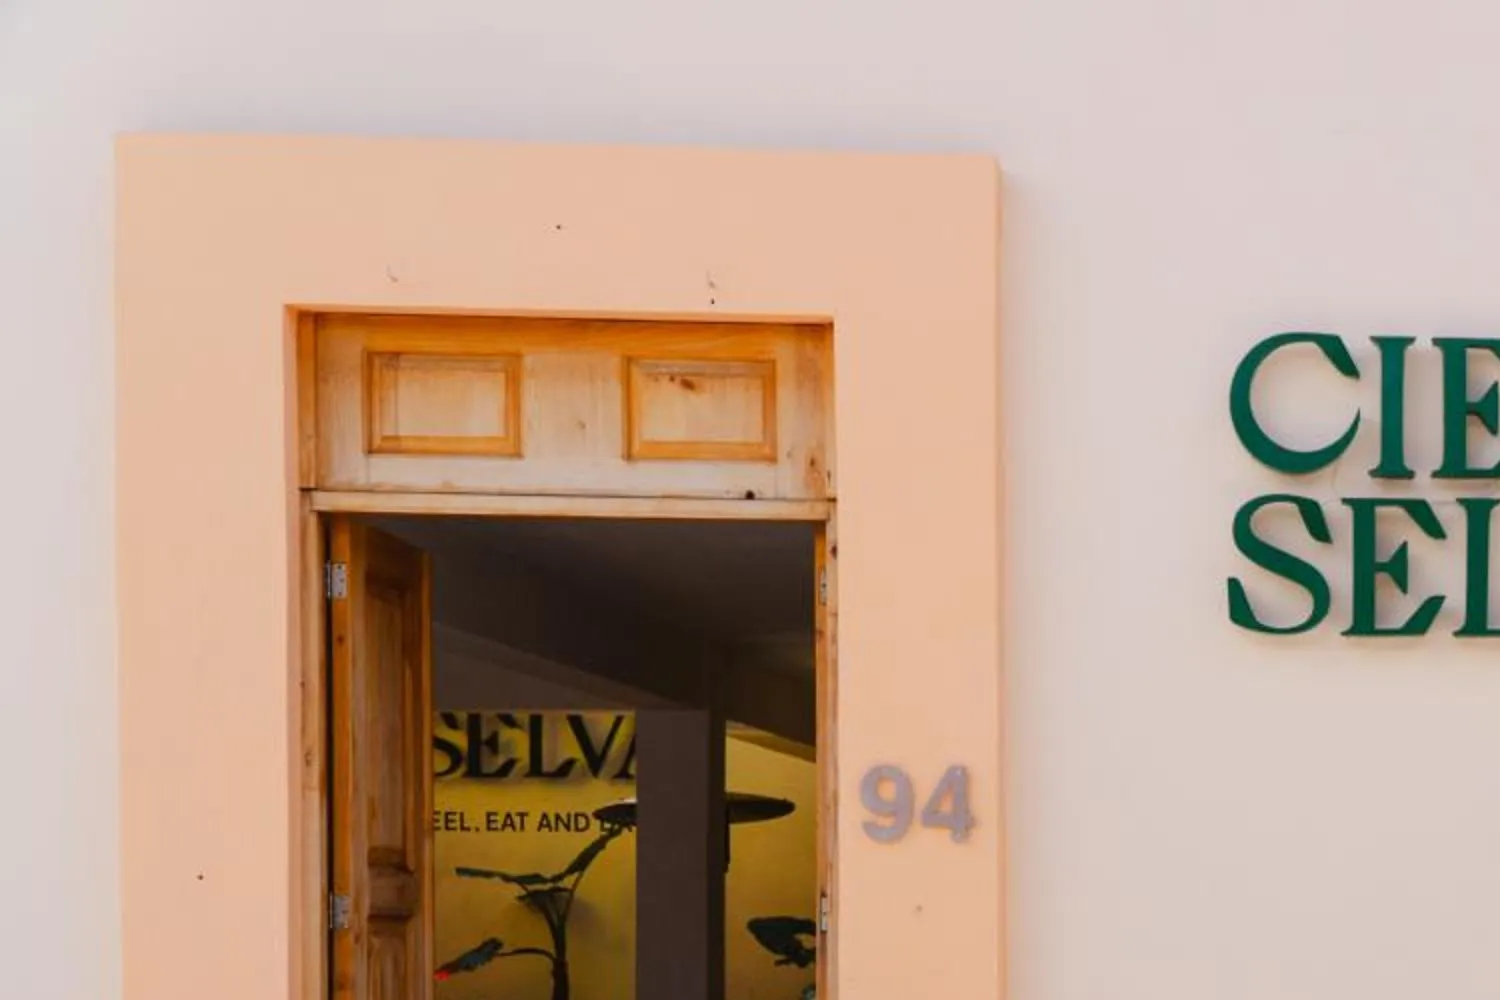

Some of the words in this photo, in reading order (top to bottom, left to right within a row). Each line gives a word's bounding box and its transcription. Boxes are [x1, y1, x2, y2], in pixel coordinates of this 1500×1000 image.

[486, 811, 528, 832] EAT
[537, 811, 590, 832] AND
[860, 764, 976, 844] 94
